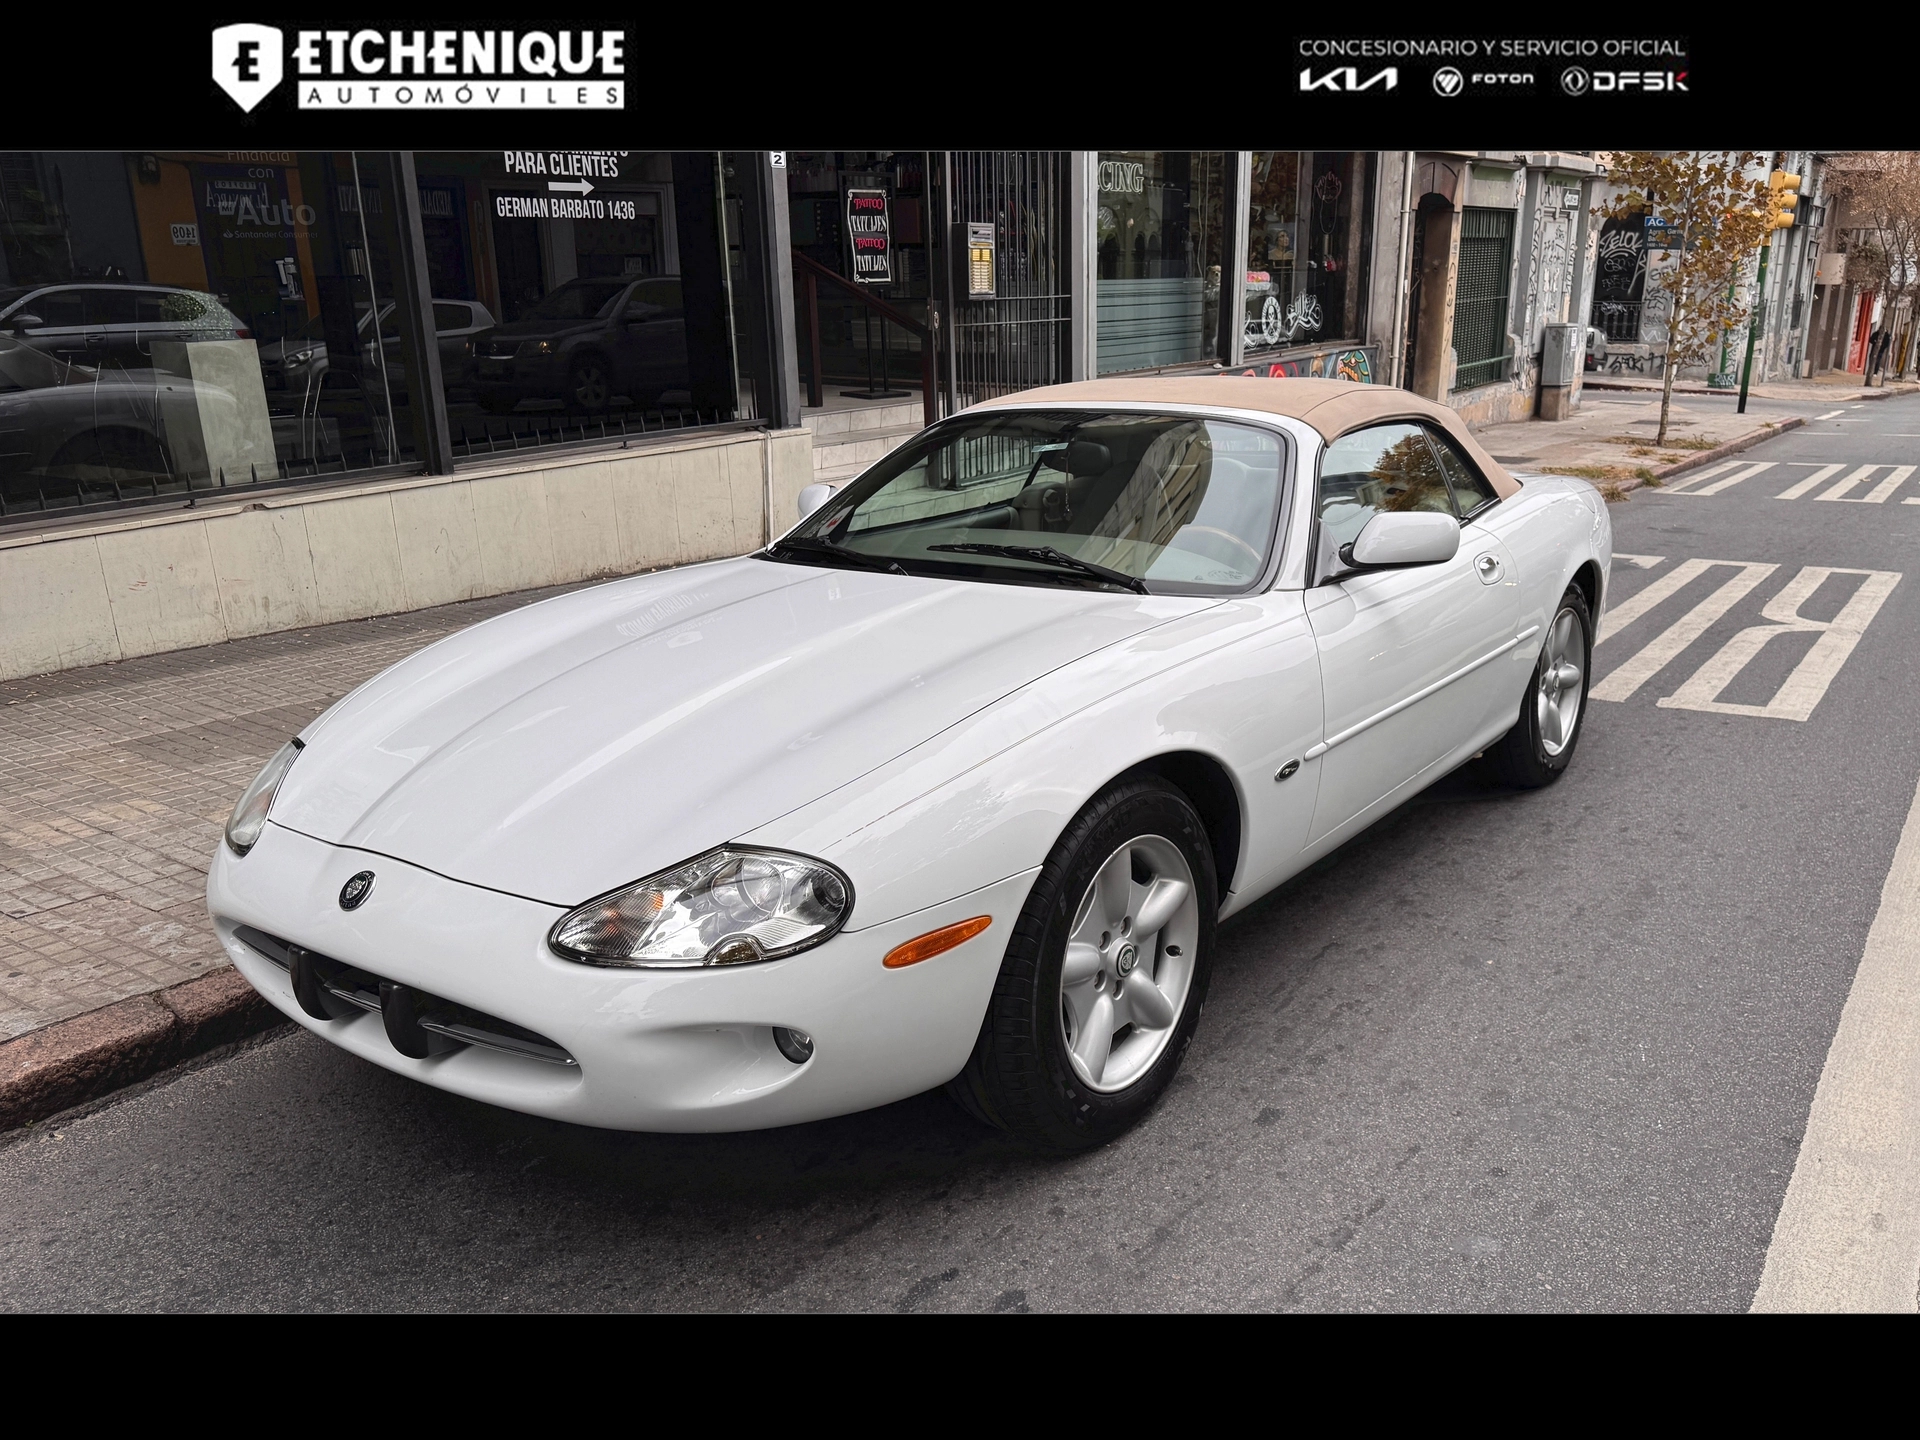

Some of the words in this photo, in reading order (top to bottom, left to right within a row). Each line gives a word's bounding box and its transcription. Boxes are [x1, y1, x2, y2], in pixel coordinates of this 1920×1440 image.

[503, 151, 547, 174] PARA
[549, 153, 619, 178] CLIENTES
[247, 168, 275, 178] con
[496, 196, 549, 218] GERMAN
[550, 198, 605, 219] BARBATO
[608, 200, 636, 220] 1436
[853, 198, 884, 210] TATTOO
[237, 197, 317, 226] Auto
[234, 230, 277, 239] Santander
[278, 231, 319, 239] Consumer
[855, 238, 886, 250] TATTOO
